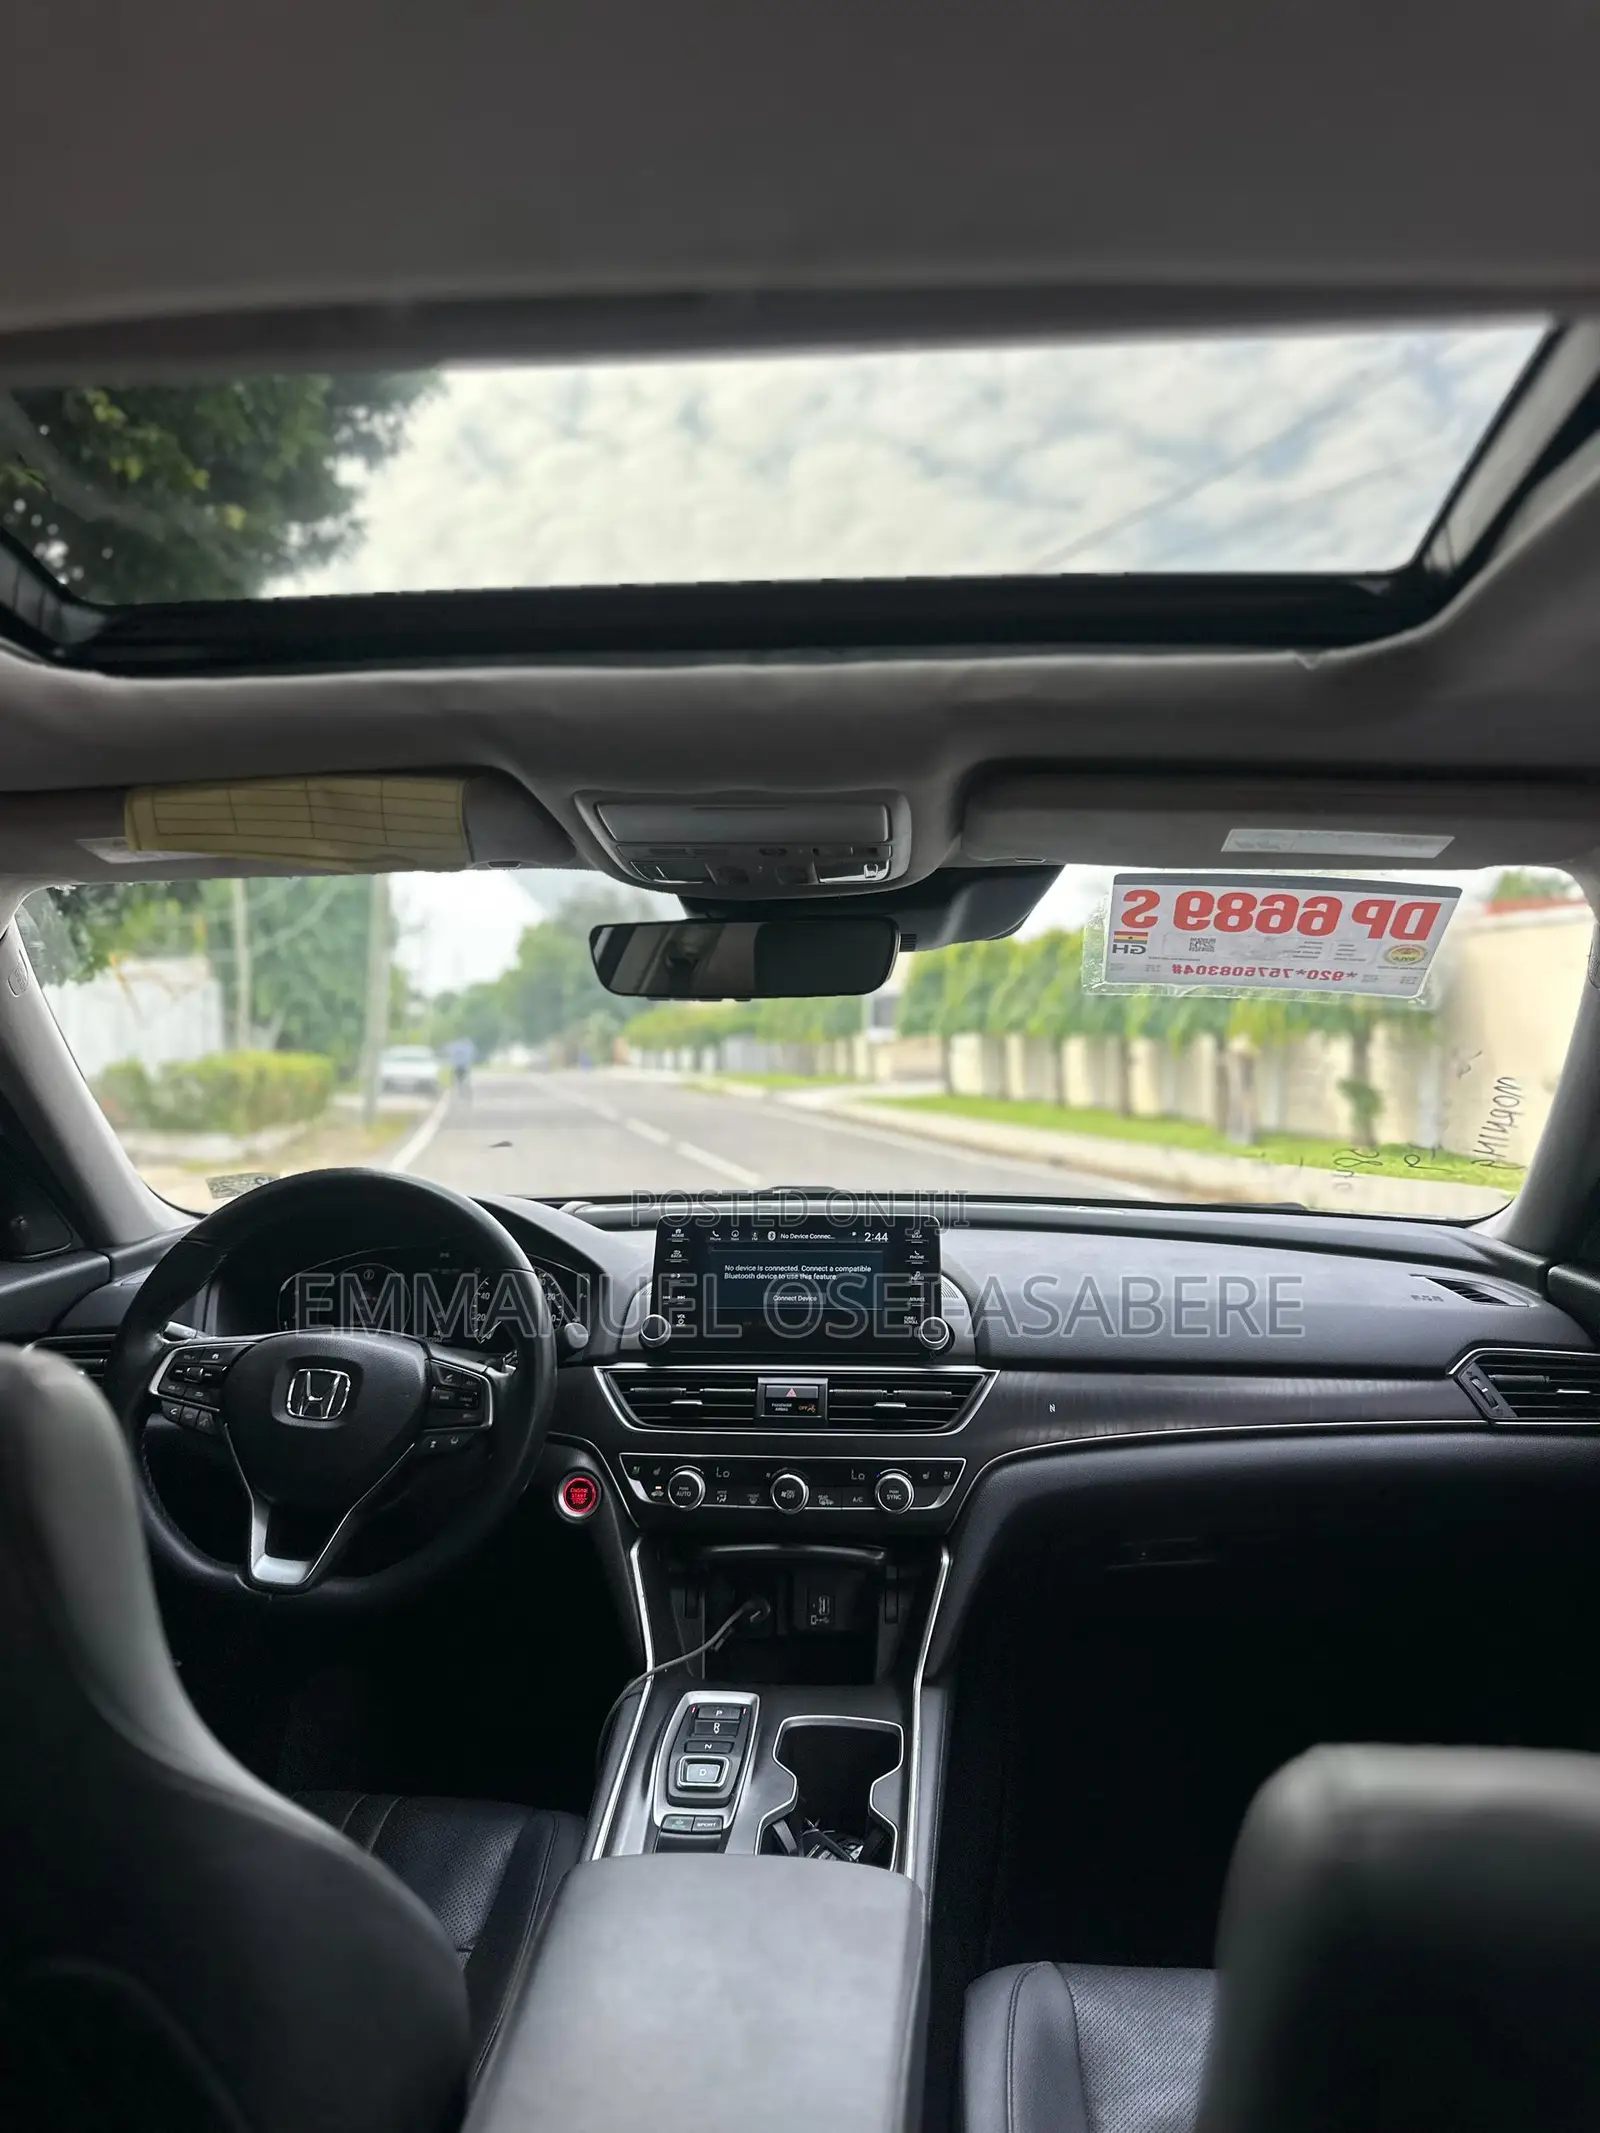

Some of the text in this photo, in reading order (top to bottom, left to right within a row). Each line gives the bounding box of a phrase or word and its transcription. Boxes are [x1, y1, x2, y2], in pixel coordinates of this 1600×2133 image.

[864, 1231, 889, 1242] 2:44
[801, 1265, 828, 1273] Connect
[835, 1265, 872, 1275] compatible
[480, 1291, 491, 1300] 40
[772, 1294, 818, 1303] Connect Device
[716, 1709, 723, 1717] P
